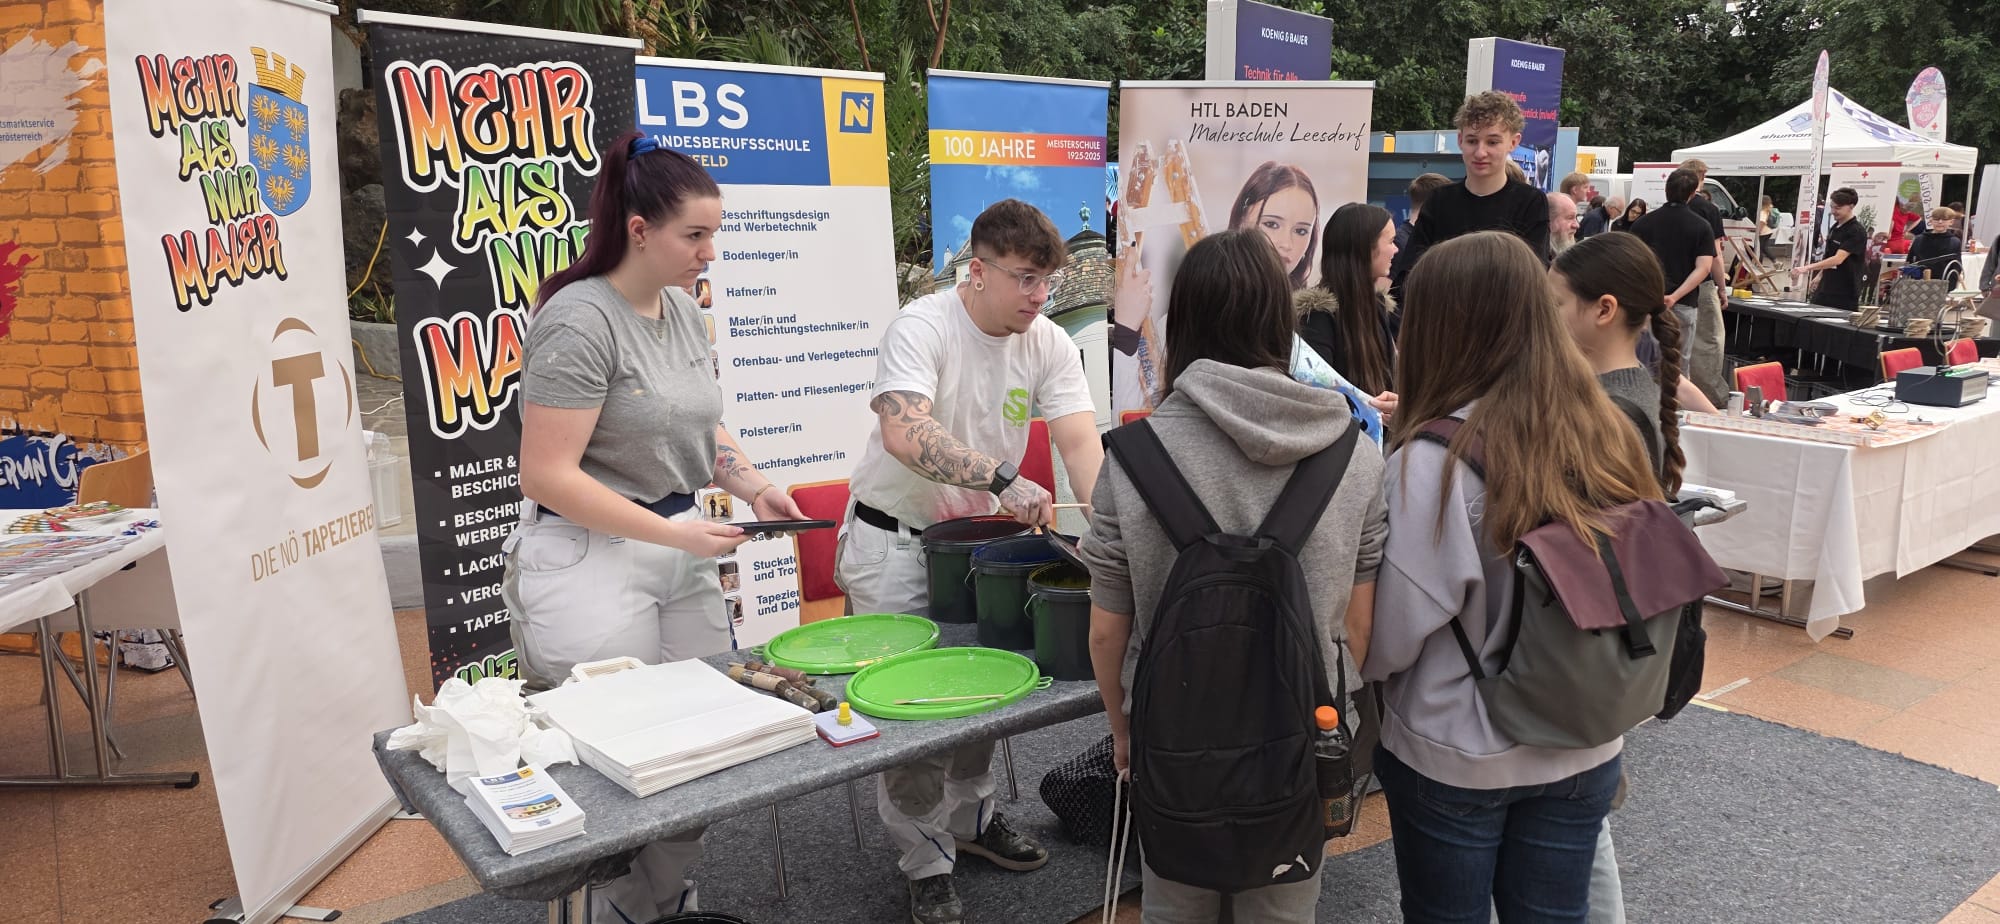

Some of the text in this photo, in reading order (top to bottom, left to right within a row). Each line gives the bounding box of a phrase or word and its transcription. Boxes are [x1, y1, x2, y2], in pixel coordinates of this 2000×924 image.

[1261, 27, 1284, 40] KOENIG
[1290, 32, 1308, 46] BAUER
[1244, 65, 1271, 80] Technik
[136, 54, 246, 138] MEHR
[636, 79, 749, 129] LBS
[1191, 102, 1288, 118] HTL BADEN
[386, 60, 600, 192] MEHR
[653, 135, 811, 152] ANDESBERUFSSCHULE
[1046, 139, 1101, 150] MEISTERSCHULE
[1188, 121, 1366, 151] Malerschule Leesdorf
[179, 120, 237, 182] ALS
[943, 136, 1036, 159] 100 JAHRE
[690, 154, 729, 167] FELD
[200, 163, 260, 226] NUR
[454, 159, 575, 253] ALS
[721, 209, 830, 222] Beschriftungsdesign
[720, 222, 817, 232] und Werbetechnik
[162, 214, 288, 312] MALER
[722, 249, 799, 262] Bodenleger/in
[726, 286, 777, 297] Hafner/in
[729, 314, 797, 326] Maler/in und
[730, 320, 869, 338] Beschichtungstechniker/in
[732, 355, 783, 368] Ofenbau-
[785, 353, 805, 363] und
[736, 390, 778, 402] Platten-
[781, 387, 801, 398] und
[740, 422, 802, 438] Polsterer/in
[450, 455, 517, 480] MALER &
[752, 450, 846, 470] uchfangkehrer/in
[454, 501, 520, 528] BESCHRI
[456, 520, 518, 547] WERBET
[251, 546, 279, 582] DIE
[280, 529, 300, 568] NÖ
[458, 554, 504, 577] LACKI
[754, 570, 774, 581] und
[461, 583, 503, 604] VERG
[758, 599, 800, 616] und Dek
[464, 608, 510, 633] TAPEZ
